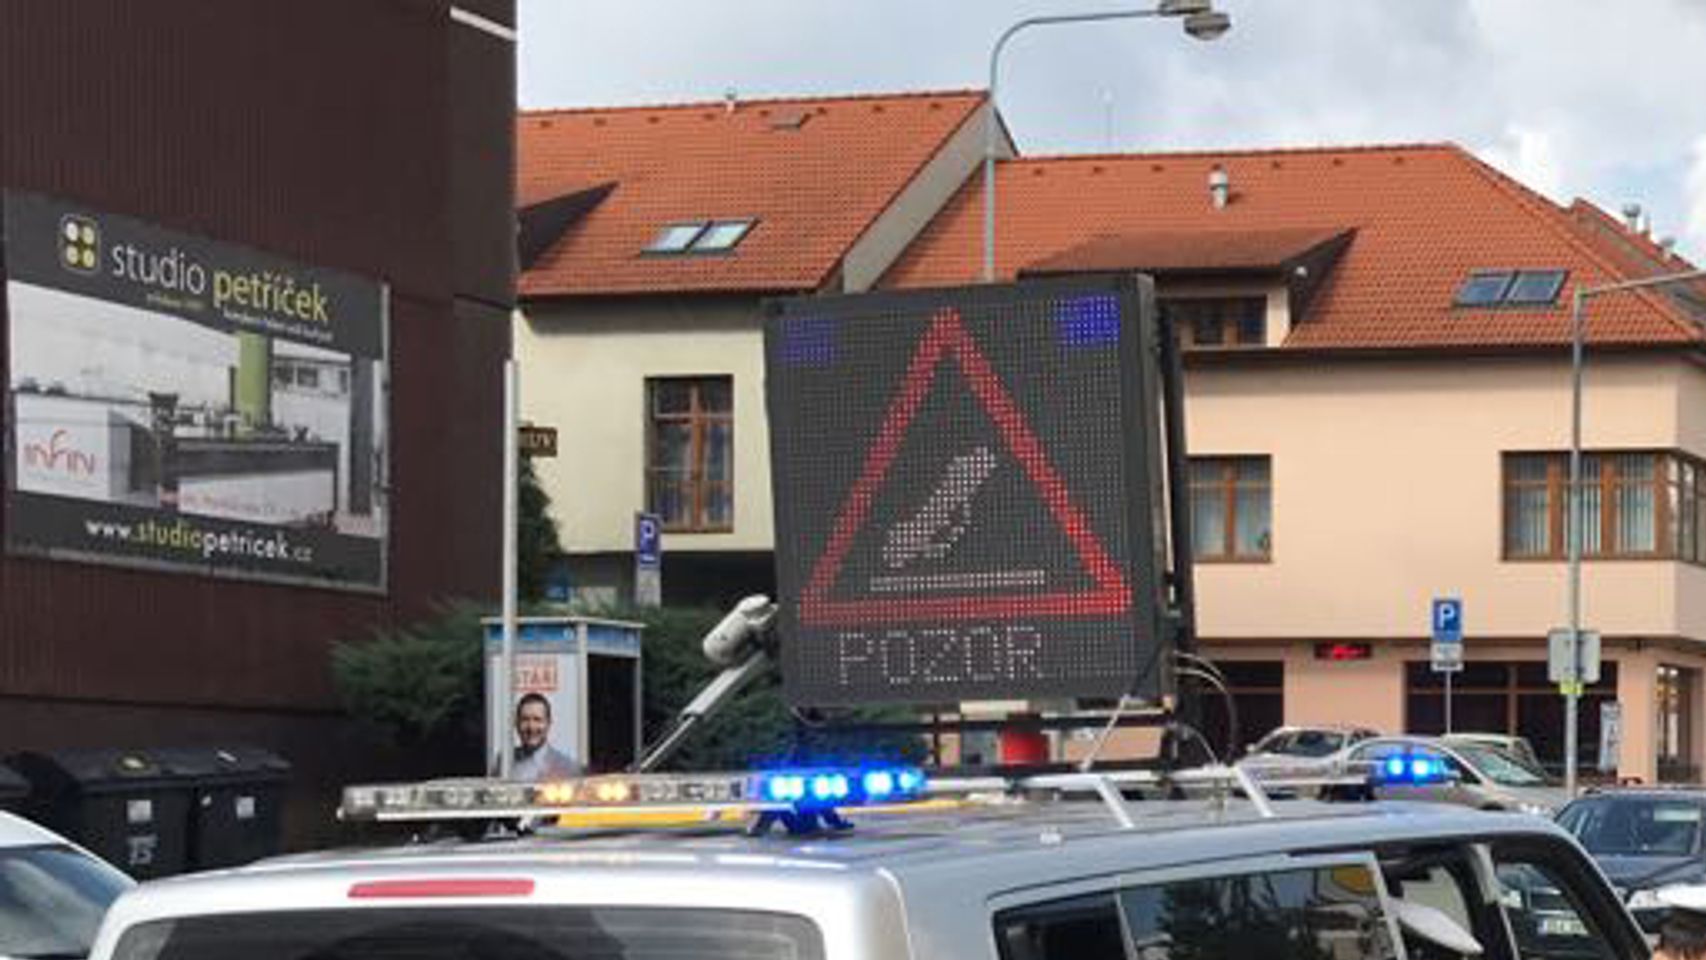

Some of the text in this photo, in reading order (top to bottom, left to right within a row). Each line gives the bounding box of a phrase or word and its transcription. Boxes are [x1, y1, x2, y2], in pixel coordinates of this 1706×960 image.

[112, 245, 206, 295] studio
[1439, 603, 1456, 629] P
[840, 626, 1043, 685] POZOR
